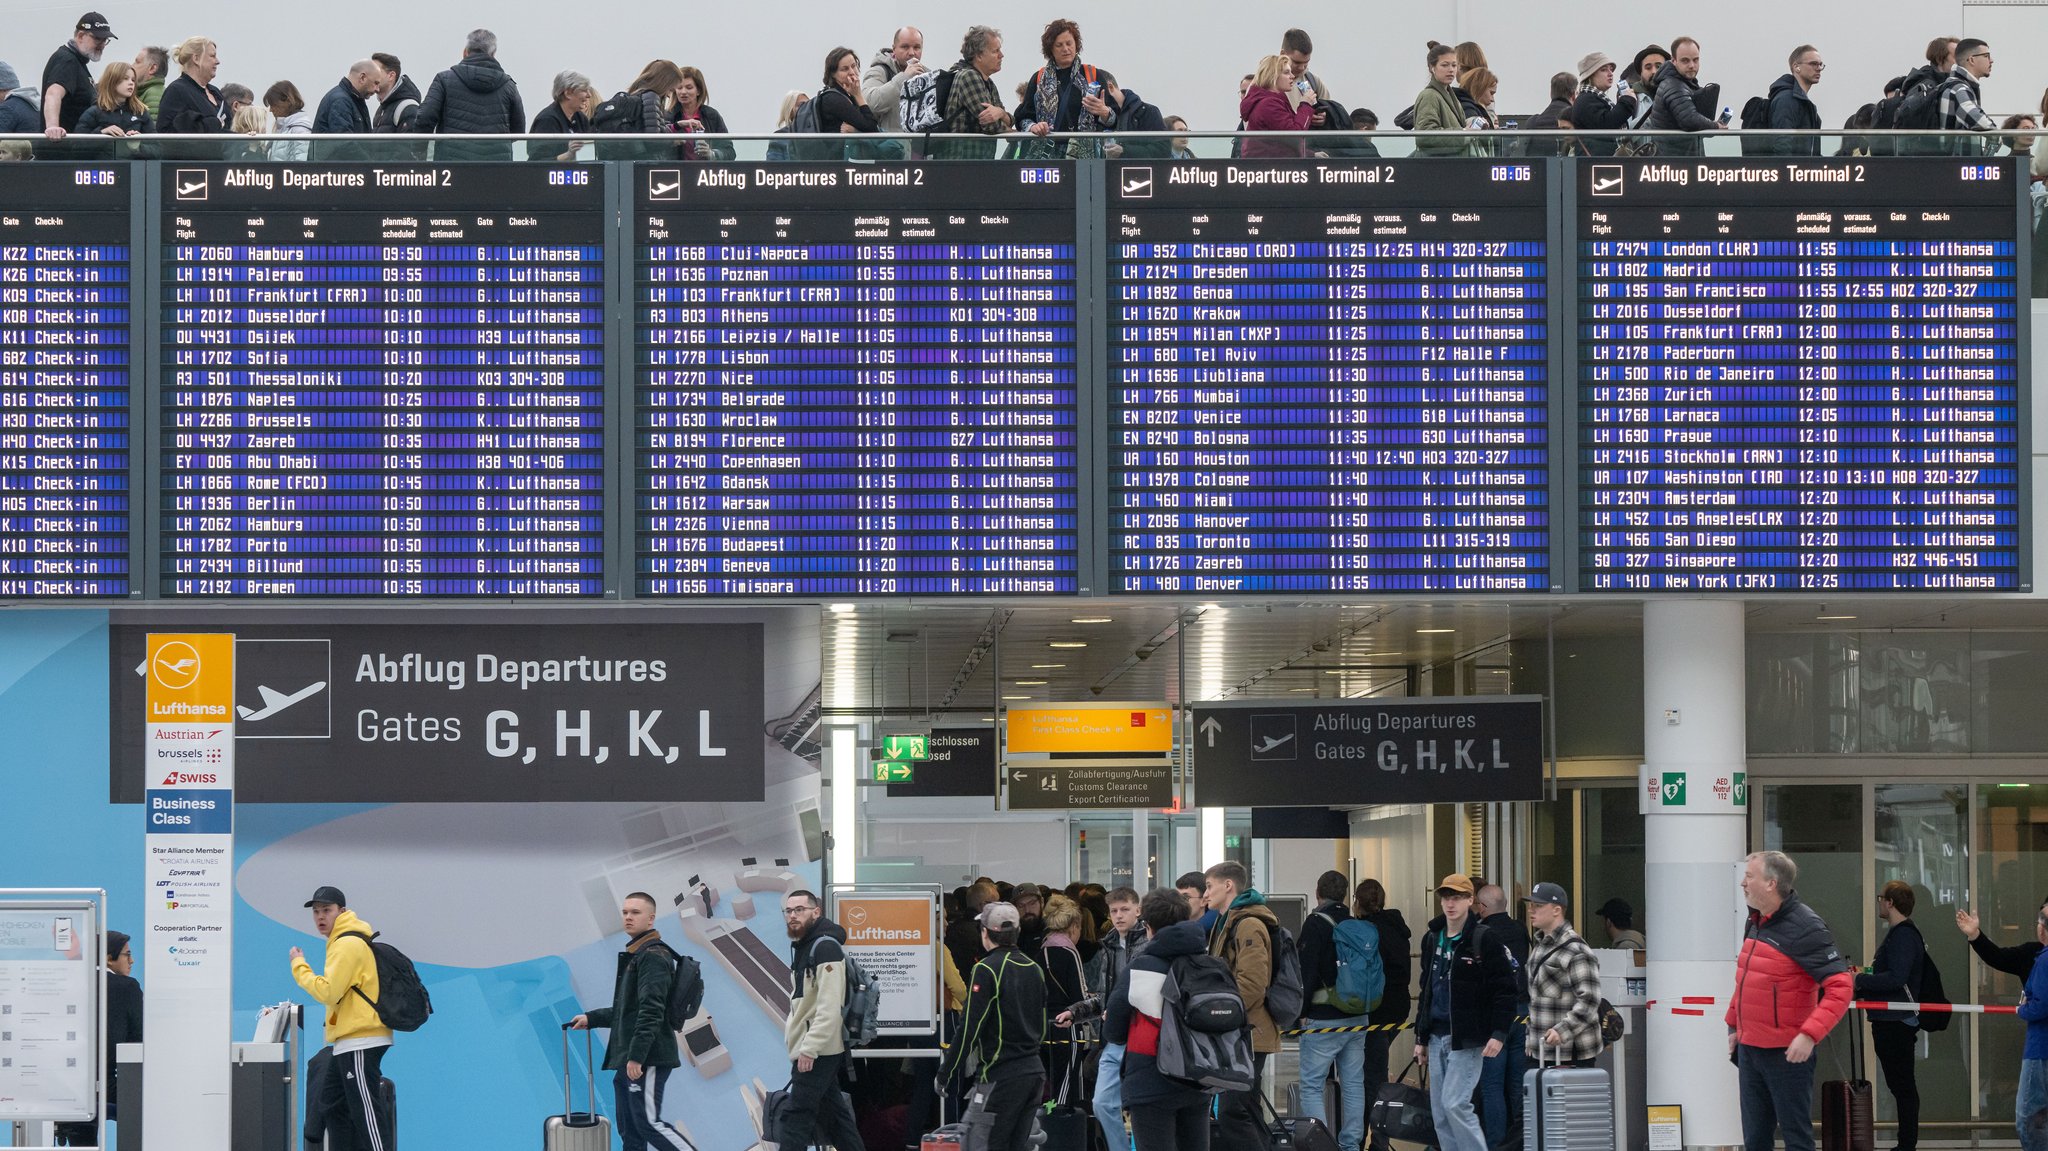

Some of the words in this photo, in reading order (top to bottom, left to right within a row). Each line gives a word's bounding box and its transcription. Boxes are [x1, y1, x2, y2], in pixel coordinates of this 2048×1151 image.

[75, 171, 114, 185] 08:06
[224, 169, 274, 190] Abflug
[283, 169, 365, 190] Departures
[373, 169, 437, 187] Terminal
[442, 170, 452, 187] 2
[549, 171, 588, 185] 08:06
[697, 169, 746, 190] Abflug
[756, 169, 837, 190] Departures
[845, 169, 909, 186] Terminal
[914, 169, 924, 186] 2
[1021, 169, 1060, 184] 08:06
[1169, 167, 1218, 188] Abflug
[1228, 167, 1309, 188] Departures
[1317, 166, 1380, 184] Terminal
[1385, 166, 1395, 183] 2
[1492, 167, 1530, 181] 08:06
[1640, 165, 1689, 186] Abflug
[1698, 165, 1779, 186] Departures
[1787, 165, 1850, 182] Terminal
[1855, 165, 1865, 182] 2
[1961, 167, 2001, 181] 08:06
[3, 217, 20, 226] Gate
[176, 217, 191, 227] Flug
[247, 217, 264, 226] nach
[303, 217, 319, 226] über
[382, 217, 418, 227] planmäßig
[430, 218, 459, 226] vorauss.
[477, 217, 493, 226] Gate
[176, 230, 196, 239] Flight
[248, 230, 256, 239] to
[303, 230, 315, 239] via
[382, 230, 417, 239] scheduled
[430, 230, 464, 239] estimated
[4, 247, 28, 261] K22
[36, 247, 99, 261] Check-in
[1594, 284, 1609, 298] UA
[1625, 284, 1649, 298] 195
[1664, 284, 1688, 298] San
[1695, 284, 1767, 298] Francisco
[1798, 284, 1837, 298] 11:55
[1845, 284, 1884, 298] 12:55
[1891, 284, 1916, 298] H02
[1922, 284, 1978, 298] 320-327
[650, 309, 666, 323] A3
[682, 309, 706, 323] 803
[722, 309, 769, 323] Athens
[857, 308, 895, 323] 11:05
[950, 308, 973, 322] K01
[982, 308, 1037, 322] 304-308
[4, 331, 26, 345] K11
[35, 331, 99, 345] Check-in
[1123, 348, 1138, 362] LH
[1154, 348, 1178, 362] 680
[1194, 348, 1216, 362] Tel
[1226, 348, 1257, 362] Aviv
[1329, 348, 1367, 362] 11:25
[1422, 347, 1446, 361] F12
[1454, 347, 1493, 361] Halle
[1500, 347, 1508, 361] F
[177, 372, 192, 386] A3
[209, 372, 231, 386] 501
[248, 372, 342, 386] Thessaloniki
[384, 372, 422, 386] 10:20
[478, 372, 502, 386] K03
[509, 372, 565, 386] 304-308
[177, 413, 192, 428] LH
[200, 413, 232, 428] 2286
[248, 413, 311, 428] Brussels
[384, 413, 422, 428] 10:30
[509, 413, 581, 428] Lufthansa
[355, 654, 465, 690] Abflug
[477, 654, 667, 690] Departures
[153, 702, 227, 715] Lufthansa
[1032, 714, 1079, 723] Lufthansa
[1314, 713, 1372, 734] Abflug
[1377, 712, 1476, 733] Departures
[155, 728, 205, 740] Austrian
[358, 709, 461, 742] Gates
[486, 710, 537, 765] G,
[556, 710, 609, 765] H,
[629, 710, 680, 765] K,
[699, 710, 727, 757] L
[1032, 726, 1053, 734] First
[1054, 726, 1080, 734] Class
[927, 736, 980, 746] eschlossen
[158, 749, 203, 758] brussels
[928, 751, 951, 761] osed
[1315, 742, 1366, 760] Gates
[1377, 740, 1409, 774] G,
[1416, 739, 1447, 774] H,
[1455, 739, 1485, 773] K,
[1492, 738, 1510, 769] L
[180, 774, 217, 783] SWISS
[1068, 769, 1167, 780] Zollabfertigung/Ausfuhr
[1068, 782, 1104, 791] Customs
[1106, 782, 1148, 791] Clearance
[1712, 785, 1731, 793] Notruf
[1715, 778, 1728, 786] AED
[153, 797, 216, 810] Business
[1068, 795, 1096, 804] Export
[1098, 794, 1150, 803] Certification
[153, 812, 191, 825] Class
[848, 927, 921, 940] Lufthansa
